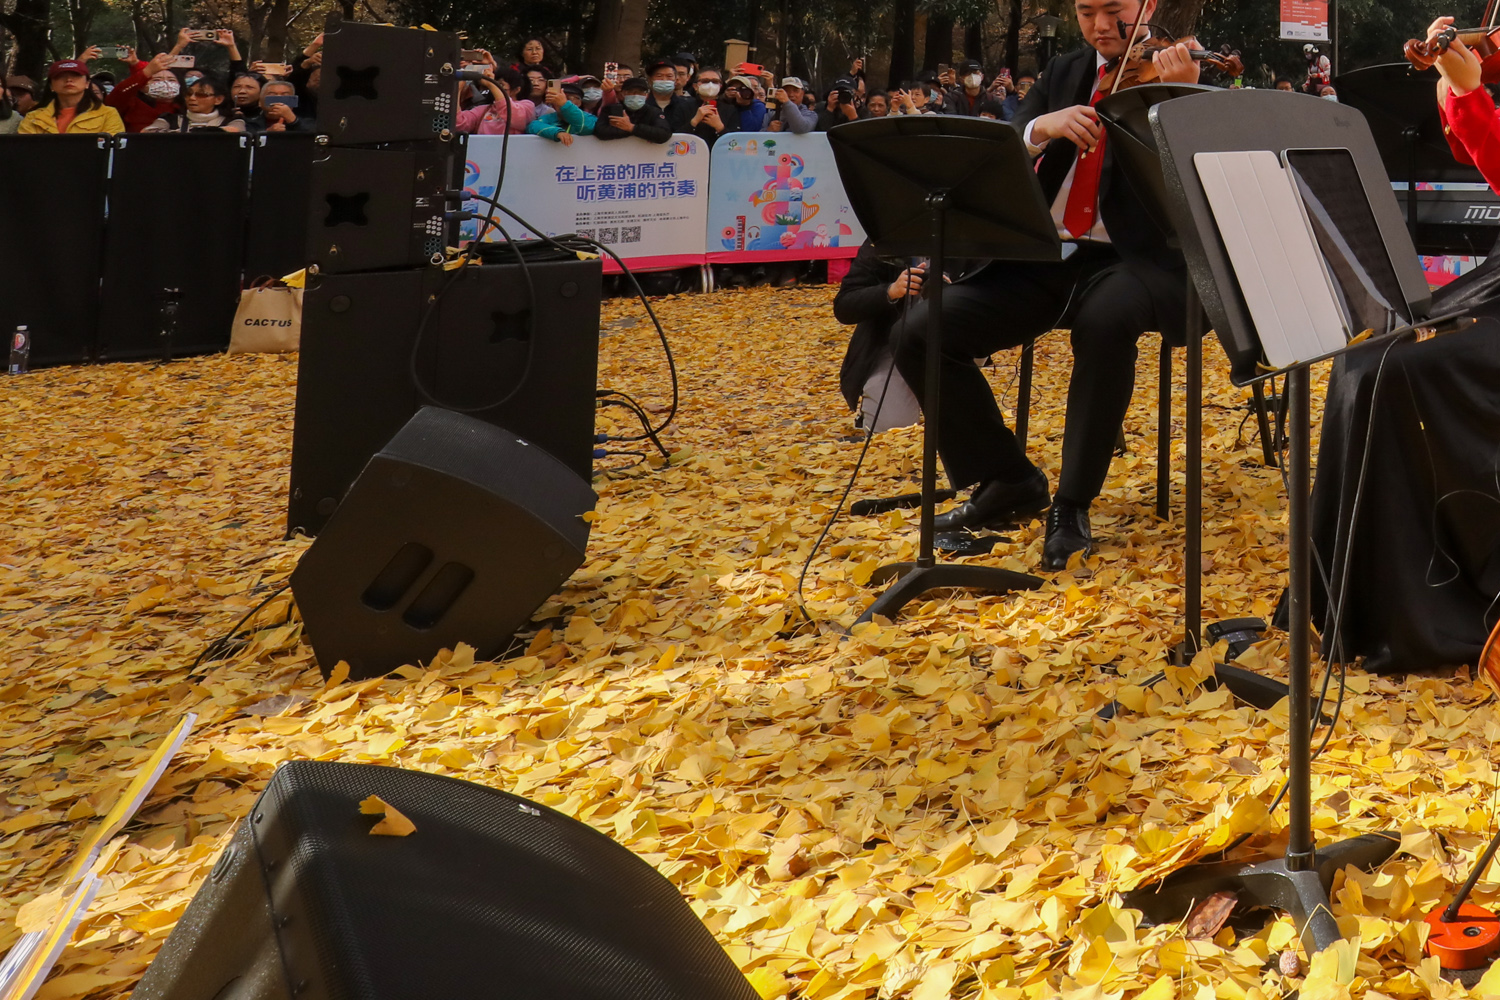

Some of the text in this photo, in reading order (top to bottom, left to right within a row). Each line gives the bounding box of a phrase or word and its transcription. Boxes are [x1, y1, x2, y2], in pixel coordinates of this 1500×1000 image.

[555, 162, 676, 183] 在上海的原点
[576, 180, 696, 201] 听黄浦的节奏
[244, 318, 292, 328] CACTUS
